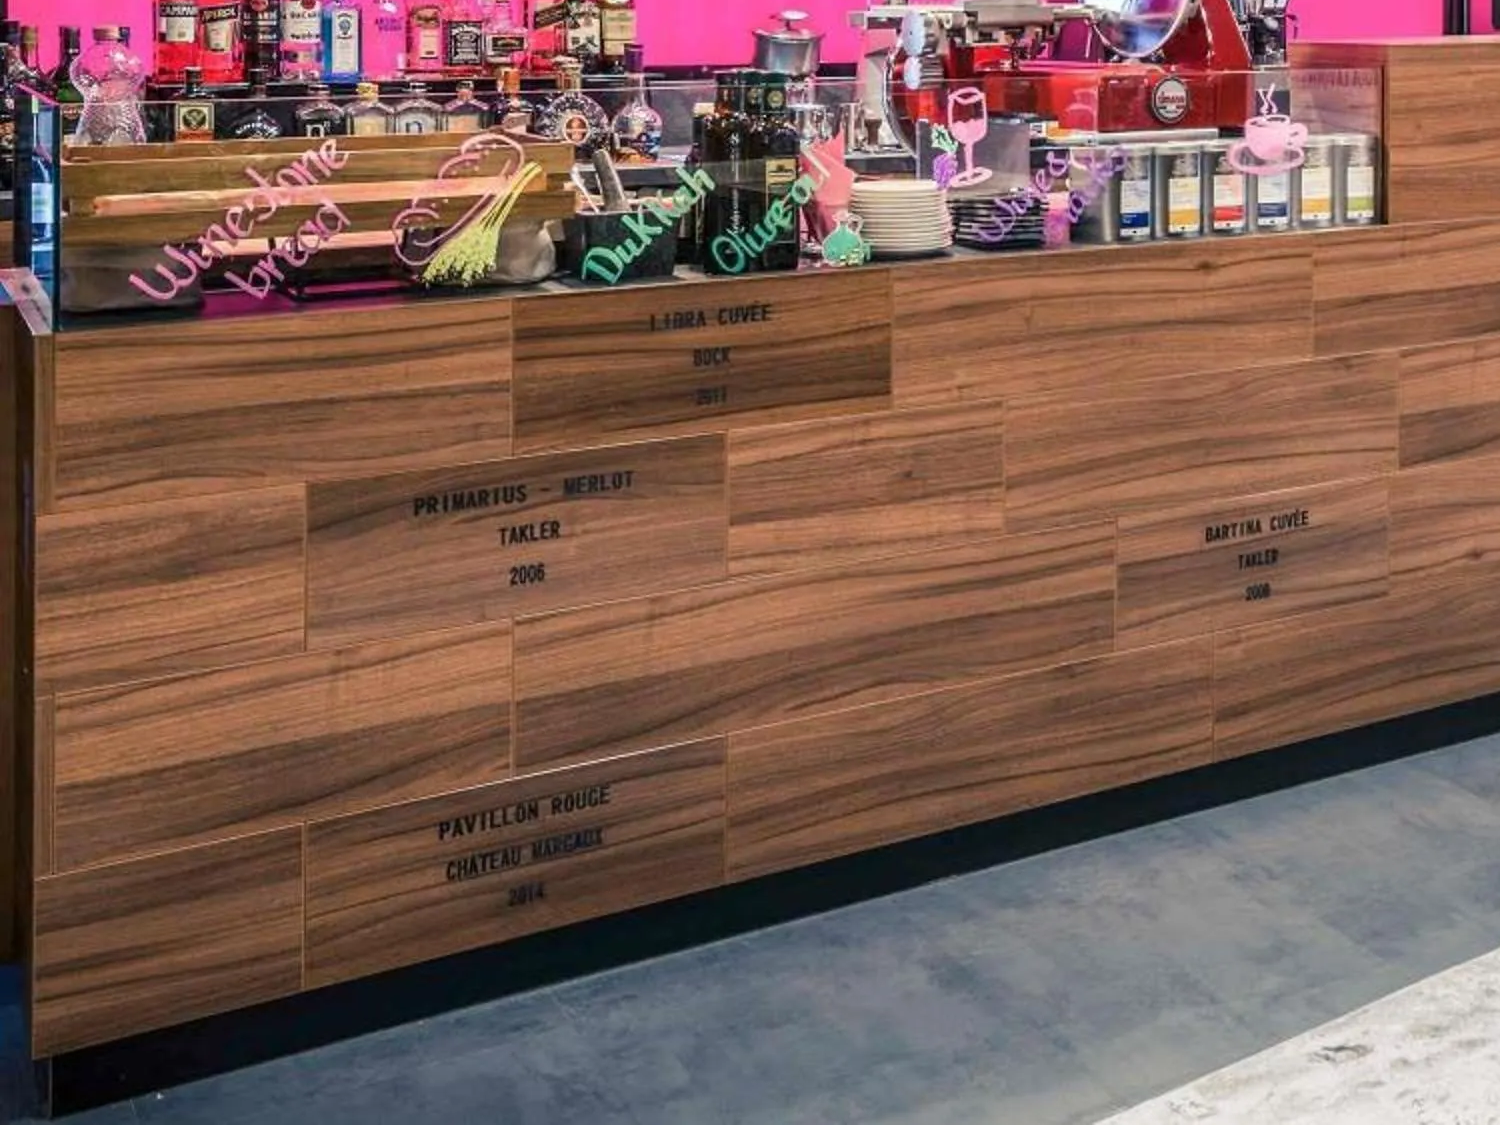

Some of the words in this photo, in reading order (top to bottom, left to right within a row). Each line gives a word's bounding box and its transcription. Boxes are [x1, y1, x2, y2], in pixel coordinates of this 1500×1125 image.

[128, 138, 350, 301] Winestone
[223, 192, 351, 300] bread
[711, 196, 794, 274] Olive
[718, 299, 772, 325] CUVÉE
[413, 483, 528, 517] PRIMARIUS
[562, 470, 635, 496] MERLOT
[497, 520, 561, 547] TAKLER
[437, 799, 540, 842] PAVILLON
[550, 784, 613, 817] ROUGE
